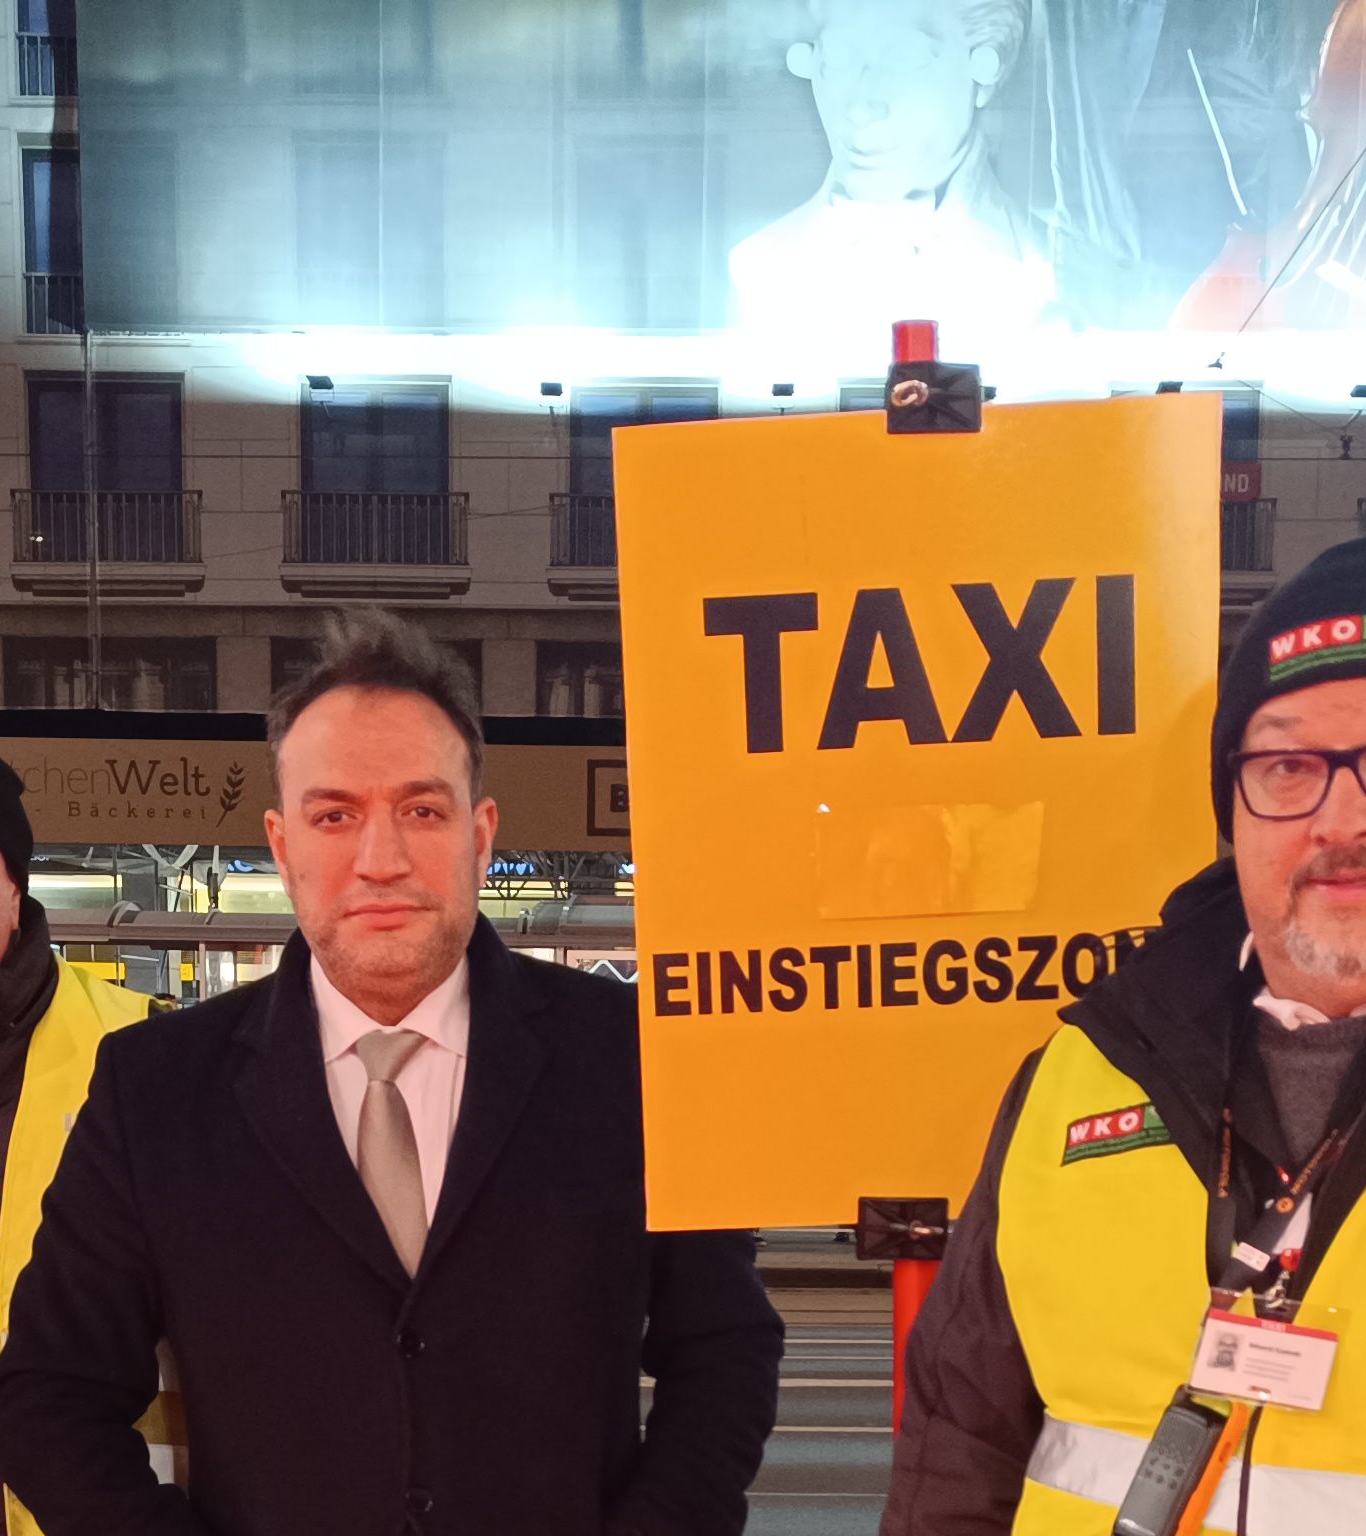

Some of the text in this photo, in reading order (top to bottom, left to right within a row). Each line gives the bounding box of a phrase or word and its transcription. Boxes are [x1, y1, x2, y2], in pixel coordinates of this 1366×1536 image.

[1271, 619, 1357, 658] WKO
[703, 574, 1136, 753] TAXI
[67, 801, 207, 820] Bäckerei
[1070, 1111, 1139, 1143] WKO
